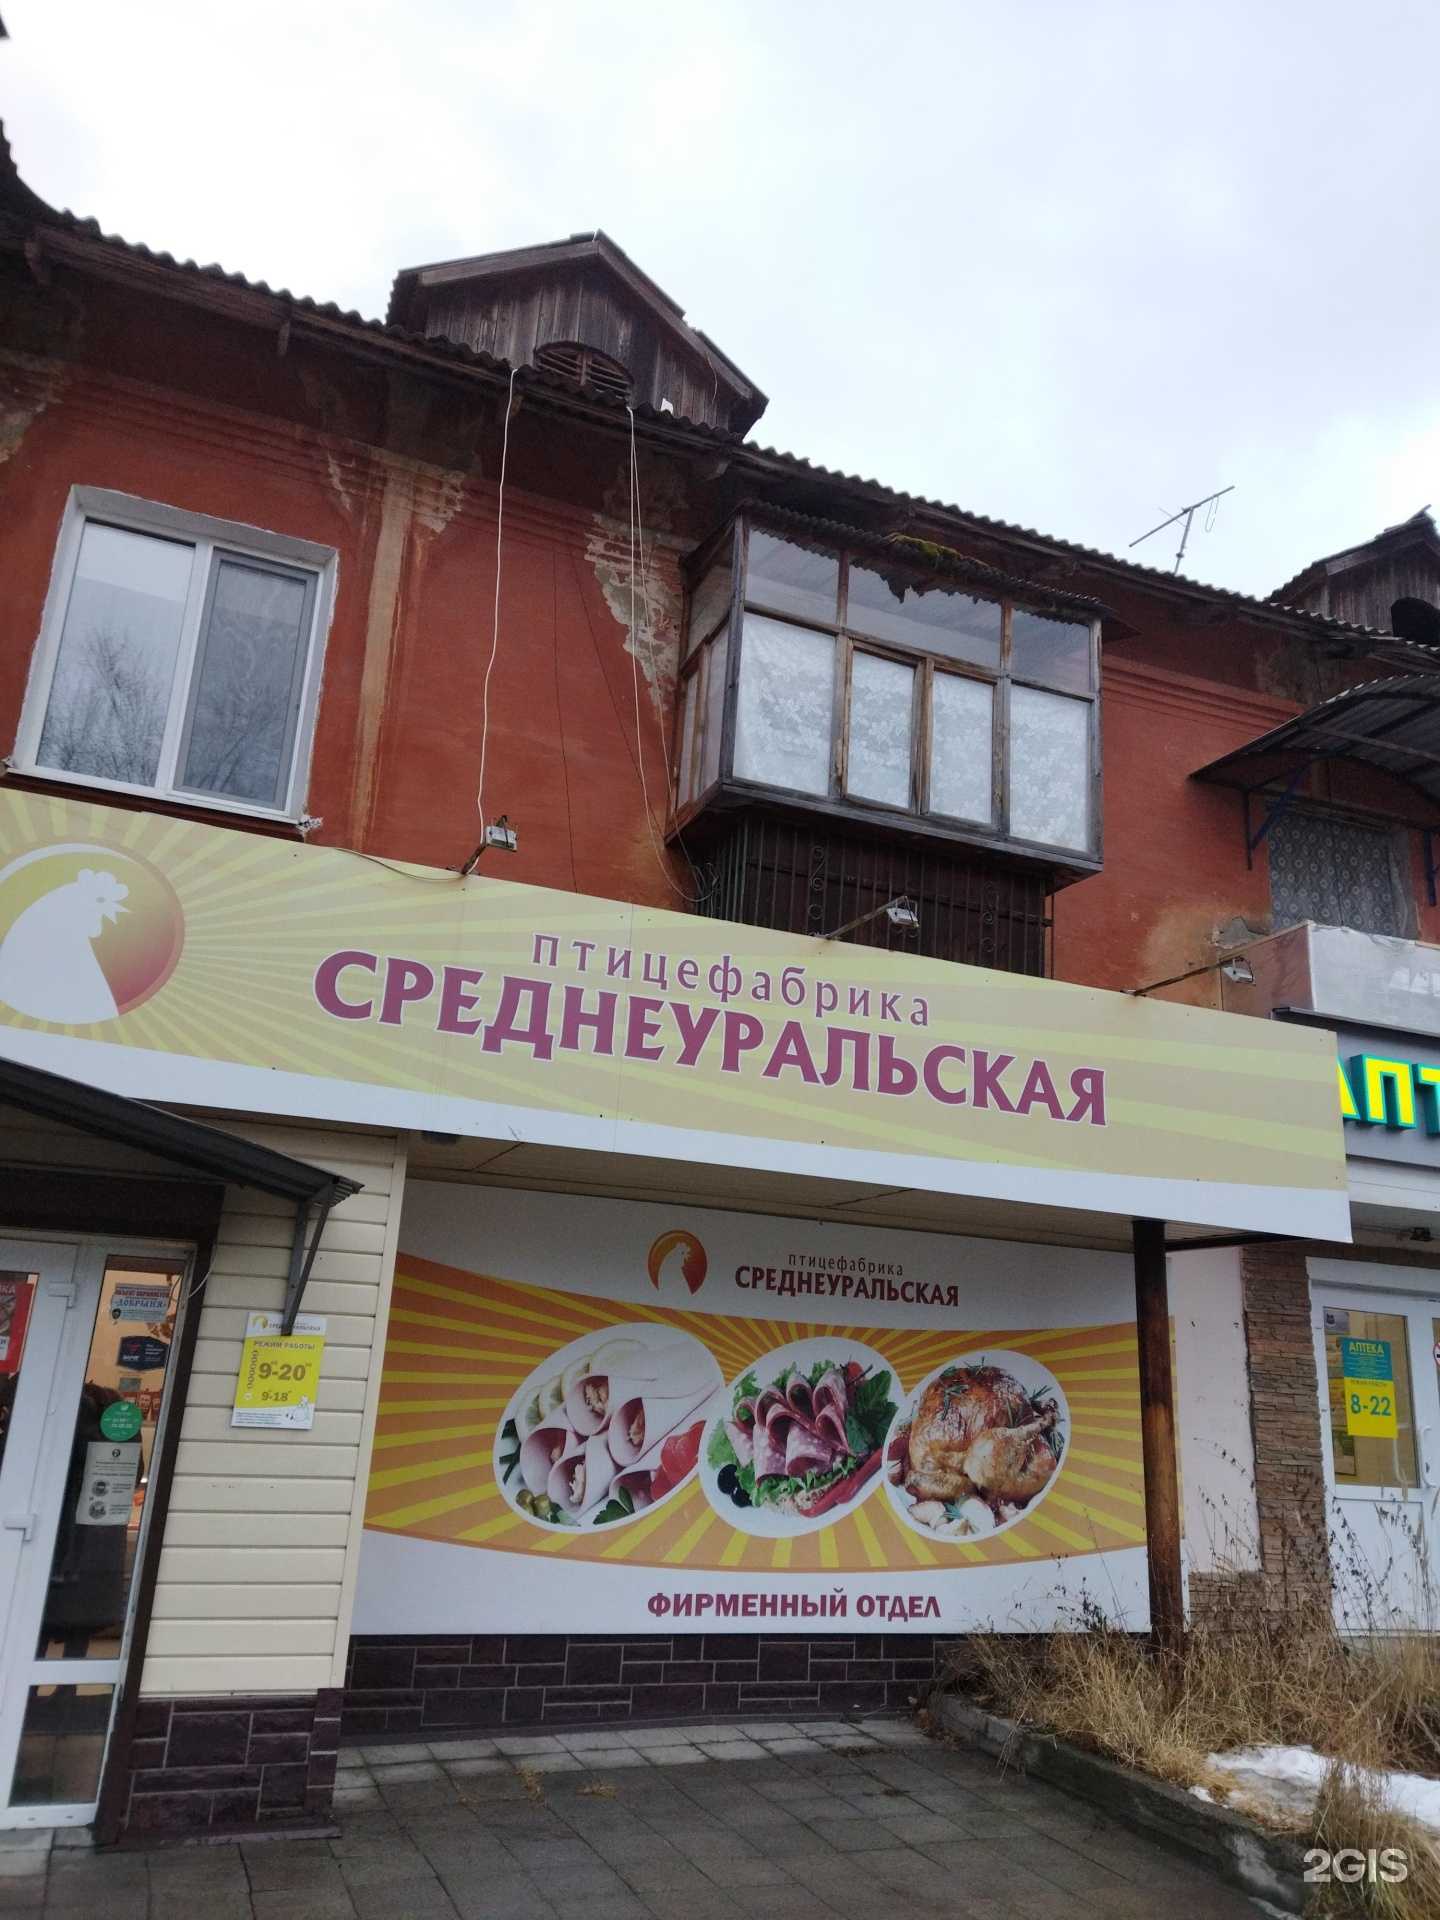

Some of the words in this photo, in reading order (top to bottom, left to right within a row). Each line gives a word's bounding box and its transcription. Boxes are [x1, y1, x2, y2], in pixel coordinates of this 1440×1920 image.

[532, 933, 930, 1026] птицефабрика
[315, 950, 1108, 1127] СРЕДНЕУРАЛЬСКАЯ
[788, 1253, 904, 1277] птицефабрика
[734, 1265, 959, 1307] СРЕДНЕУРАЛЬСКАЯ
[254, 1340, 282, 1349] РЕЖИМ
[284, 1341, 315, 1350] РАБОТЫ
[1349, 1341, 1385, 1355] АПТЕКА
[1350, 1392, 1392, 1417] 8-22
[647, 1587, 848, 1618] ФИРМЕННЫЙ
[856, 1594, 942, 1622] ОТДЕЛ
